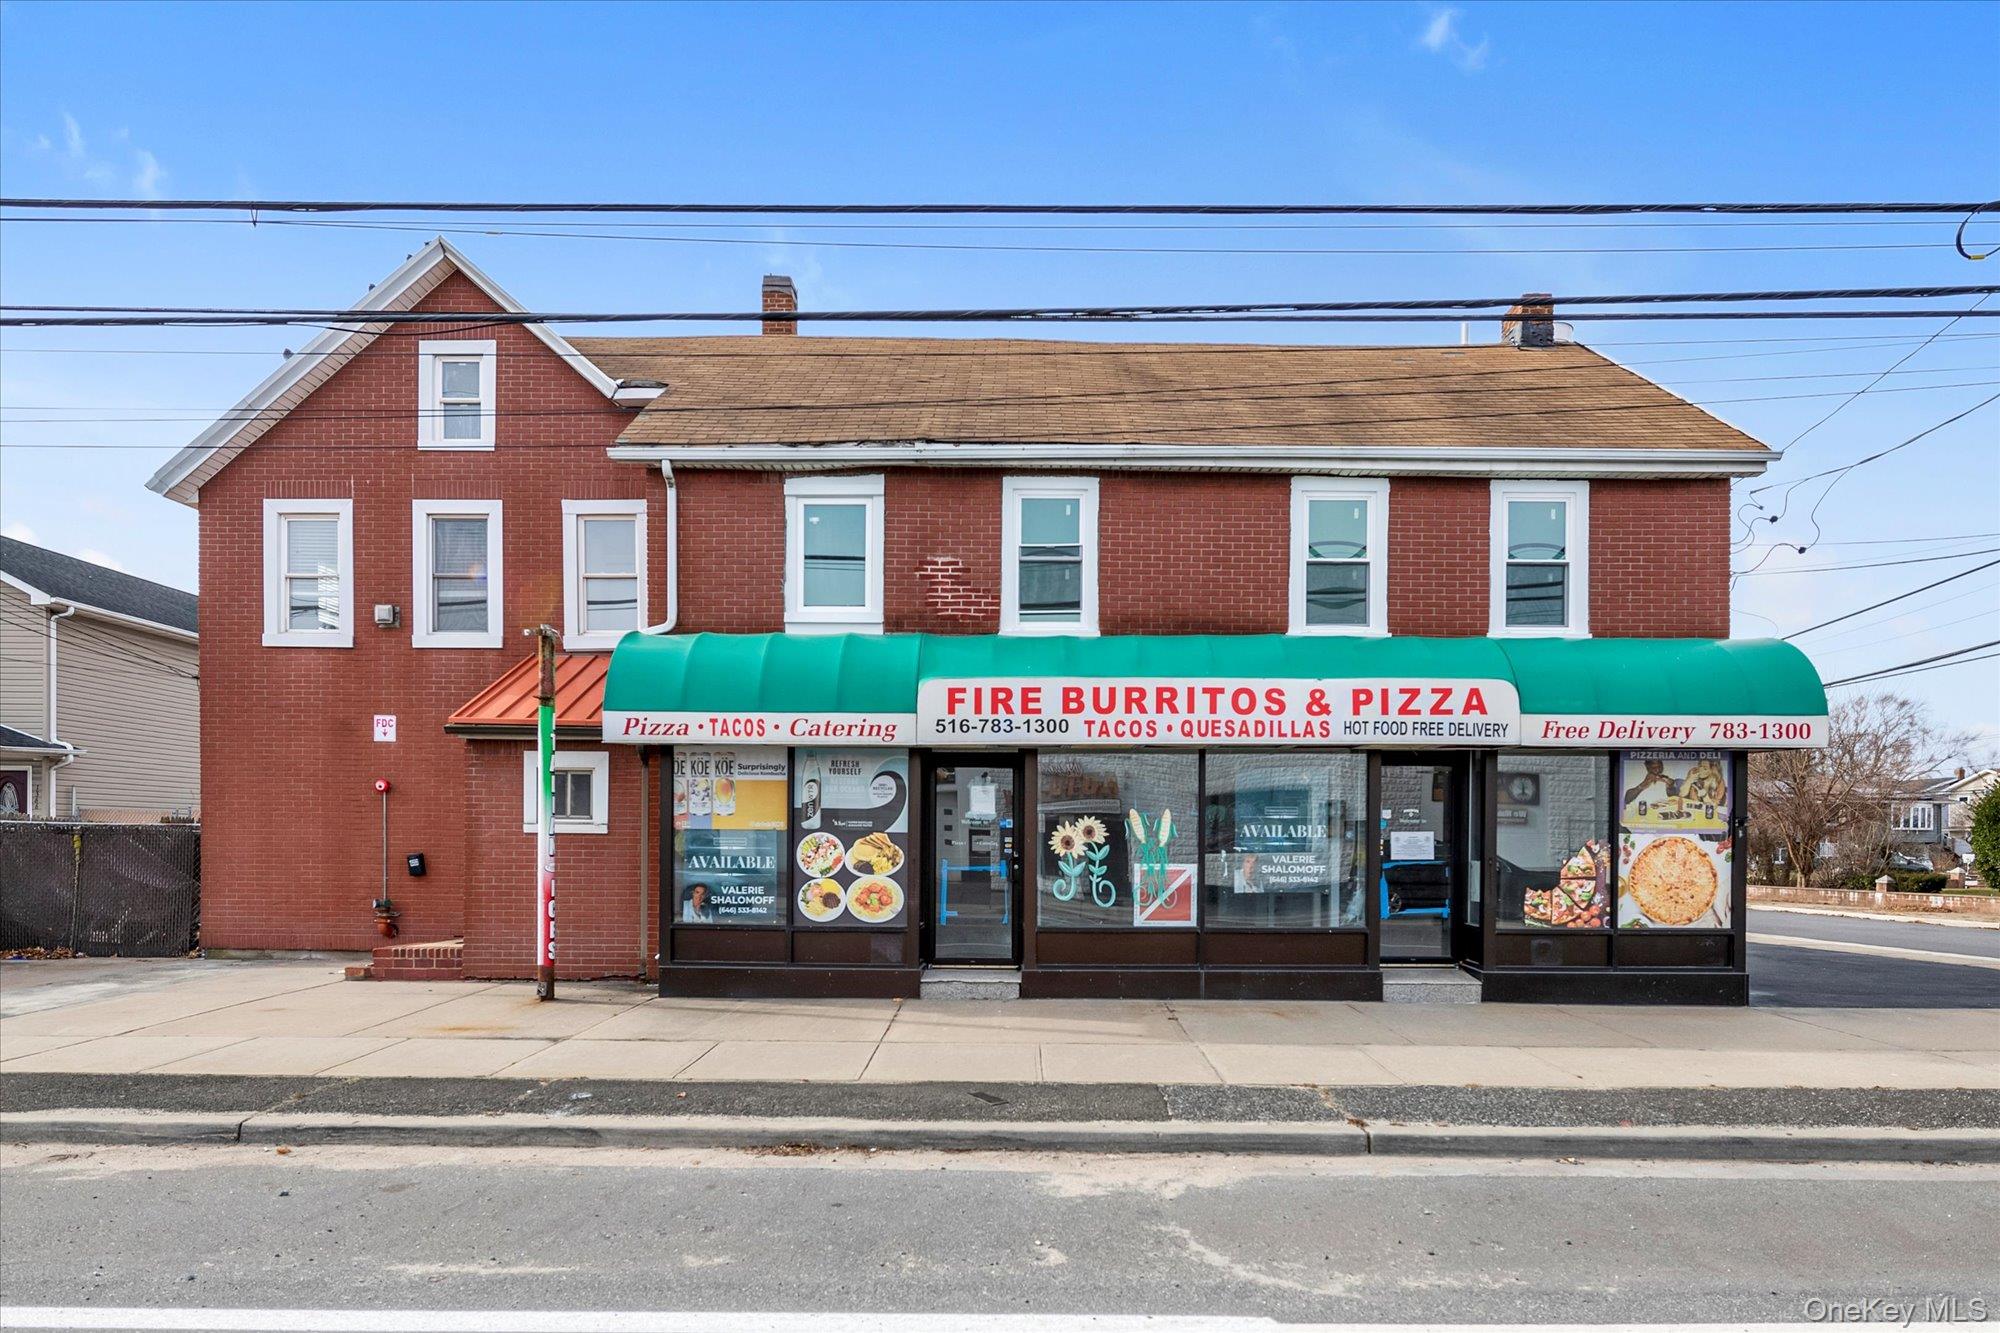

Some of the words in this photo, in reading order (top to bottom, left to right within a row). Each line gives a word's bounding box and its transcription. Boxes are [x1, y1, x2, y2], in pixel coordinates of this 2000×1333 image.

[947, 687, 1042, 715] FIRE
[1062, 687, 1286, 716] BURRITOS
[1305, 688, 1332, 716] &
[1352, 687, 1488, 716] PIZZA
[376, 719, 394, 728] FDC
[622, 717, 690, 736] Pizza
[709, 718, 766, 737] TACOS
[789, 717, 898, 742] Catering
[935, 719, 1069, 734] 516-783-1300
[1084, 719, 1157, 738] TACOS
[1180, 719, 1331, 738] QUESADILLAS
[1343, 720, 1368, 736] HOT
[1373, 720, 1408, 736] FOOD
[1412, 720, 1444, 737] FREE
[1448, 721, 1509, 738] DELIVERY
[1541, 720, 1589, 740] Free
[1598, 720, 1696, 744] Delivery
[1709, 722, 1811, 740] 783-1300
[1630, 751, 1676, 759] PIZZERIA
[1677, 751, 1697, 759] AND
[1699, 751, 1721, 759] DELI
[737, 763, 786, 771] Surprisingly
[1239, 824, 1327, 838] AVAILABLE
[688, 855, 775, 869] AVAILABLE
[1272, 855, 1316, 864] VALERIE
[1261, 865, 1327, 874] SHALOMOFF
[721, 886, 765, 895] VALERIE
[710, 896, 775, 905] SHALOMOFF
